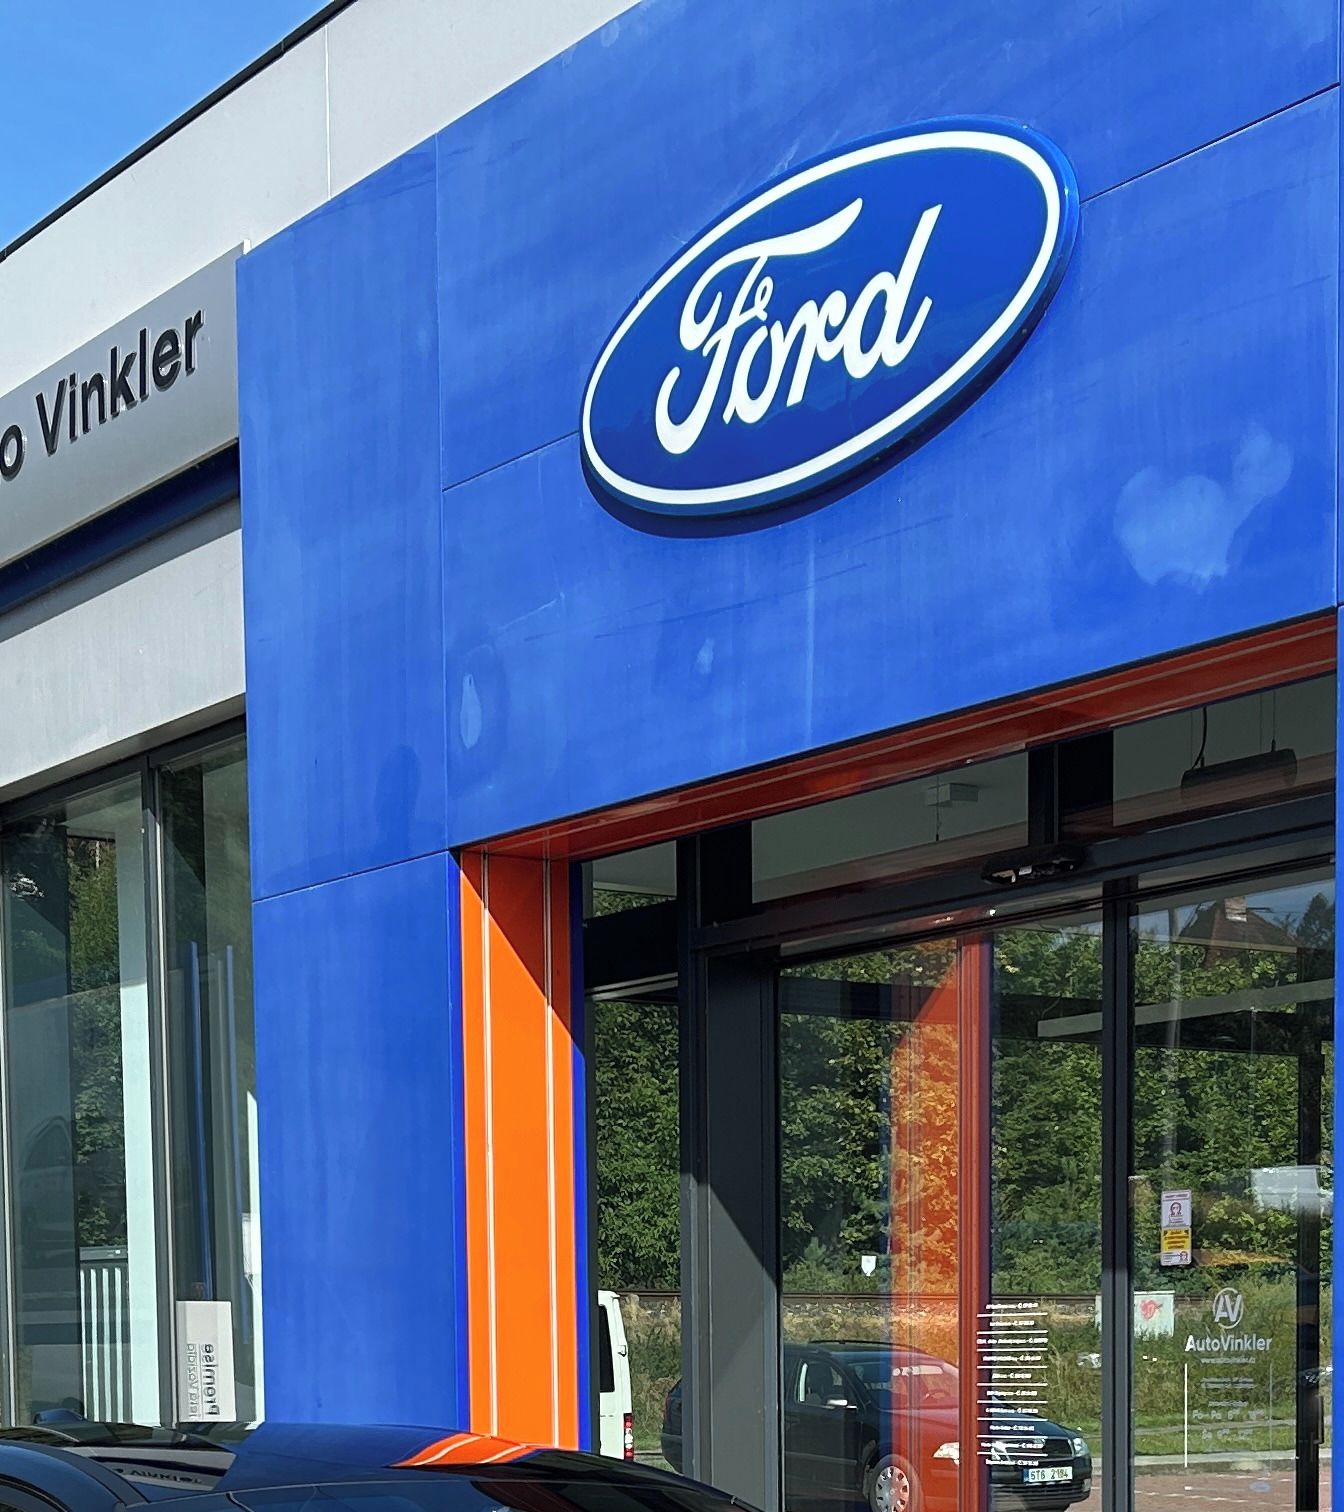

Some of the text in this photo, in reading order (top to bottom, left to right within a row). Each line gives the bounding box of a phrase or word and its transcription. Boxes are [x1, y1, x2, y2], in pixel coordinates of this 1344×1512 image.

[656, 198, 943, 455] Ford
[36, 309, 205, 456] Vinkler
[1185, 1333, 1272, 1352] AutoVinkler
[1213, 1294, 1243, 1323] AV
